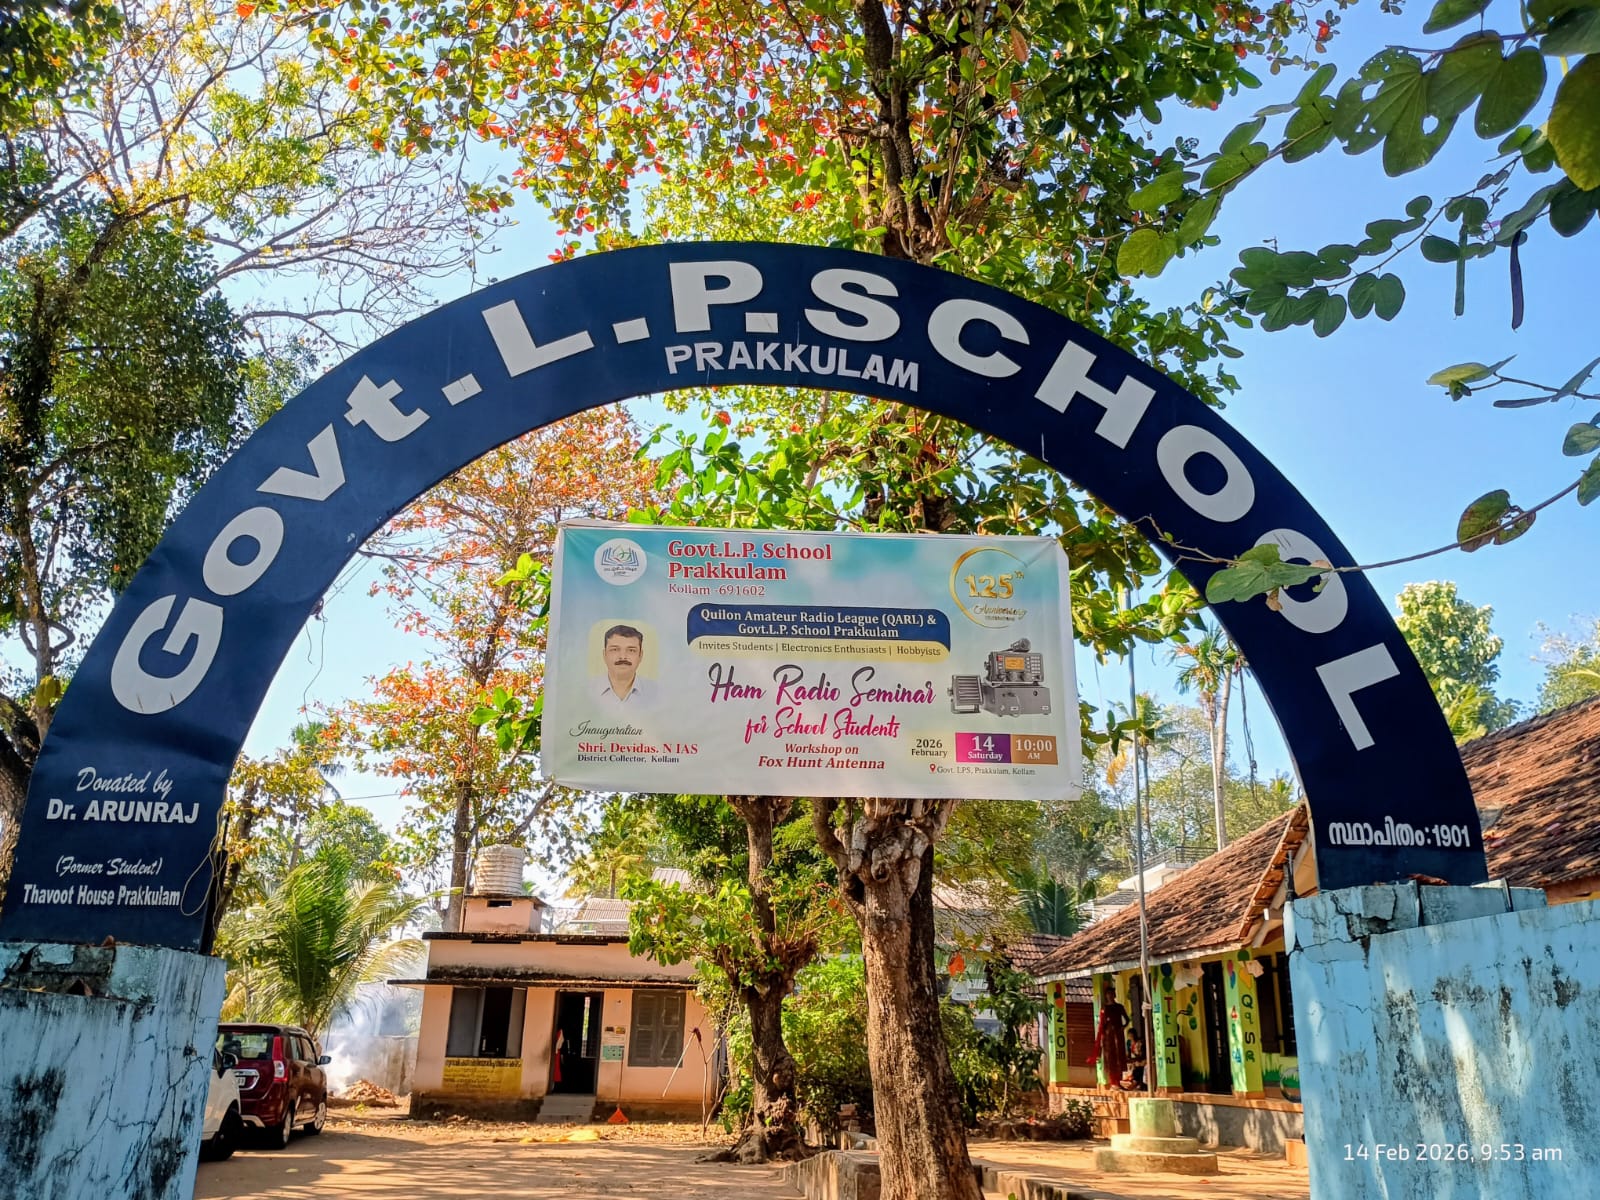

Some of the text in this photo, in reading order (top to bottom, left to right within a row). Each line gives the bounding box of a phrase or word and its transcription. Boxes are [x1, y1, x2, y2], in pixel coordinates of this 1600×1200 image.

[665, 341, 919, 392] PRAKKULAM
[762, 543, 832, 560] School
[668, 562, 787, 580] Prakkulam
[669, 583, 711, 595] Kollam
[700, 608, 937, 628] Quilon Amateur Radio League (QARL) &
[791, 624, 831, 637] School
[834, 624, 900, 638] Prakkulam
[698, 640, 731, 651] Invites
[732, 641, 774, 652] Students
[781, 642, 833, 654] Electronics
[834, 644, 887, 655] Enthusiasts
[896, 646, 942, 658] Hobbyists
[708, 662, 937, 708] Ham Radio Seminar
[569, 720, 643, 740] Inauguration
[744, 706, 901, 744] for School Students
[577, 742, 698, 755] Shri. Devidas. N IAS
[785, 743, 859, 756] Workshop on
[916, 738, 943, 749] 2026
[971, 735, 995, 752] 14
[1015, 739, 1053, 752] 10:00
[577, 754, 680, 764] District Collector, Kollam
[911, 748, 948, 758] February
[967, 751, 1003, 761] Saturday
[1027, 752, 1041, 760] AM
[758, 755, 885, 770] Fox Hunt Antenna
[76, 766, 174, 800] Donated by
[46, 798, 200, 824] Dr. ARUNRAJ
[55, 855, 104, 877] (Former
[23, 884, 182, 907] Thavoot House Prakkulam
